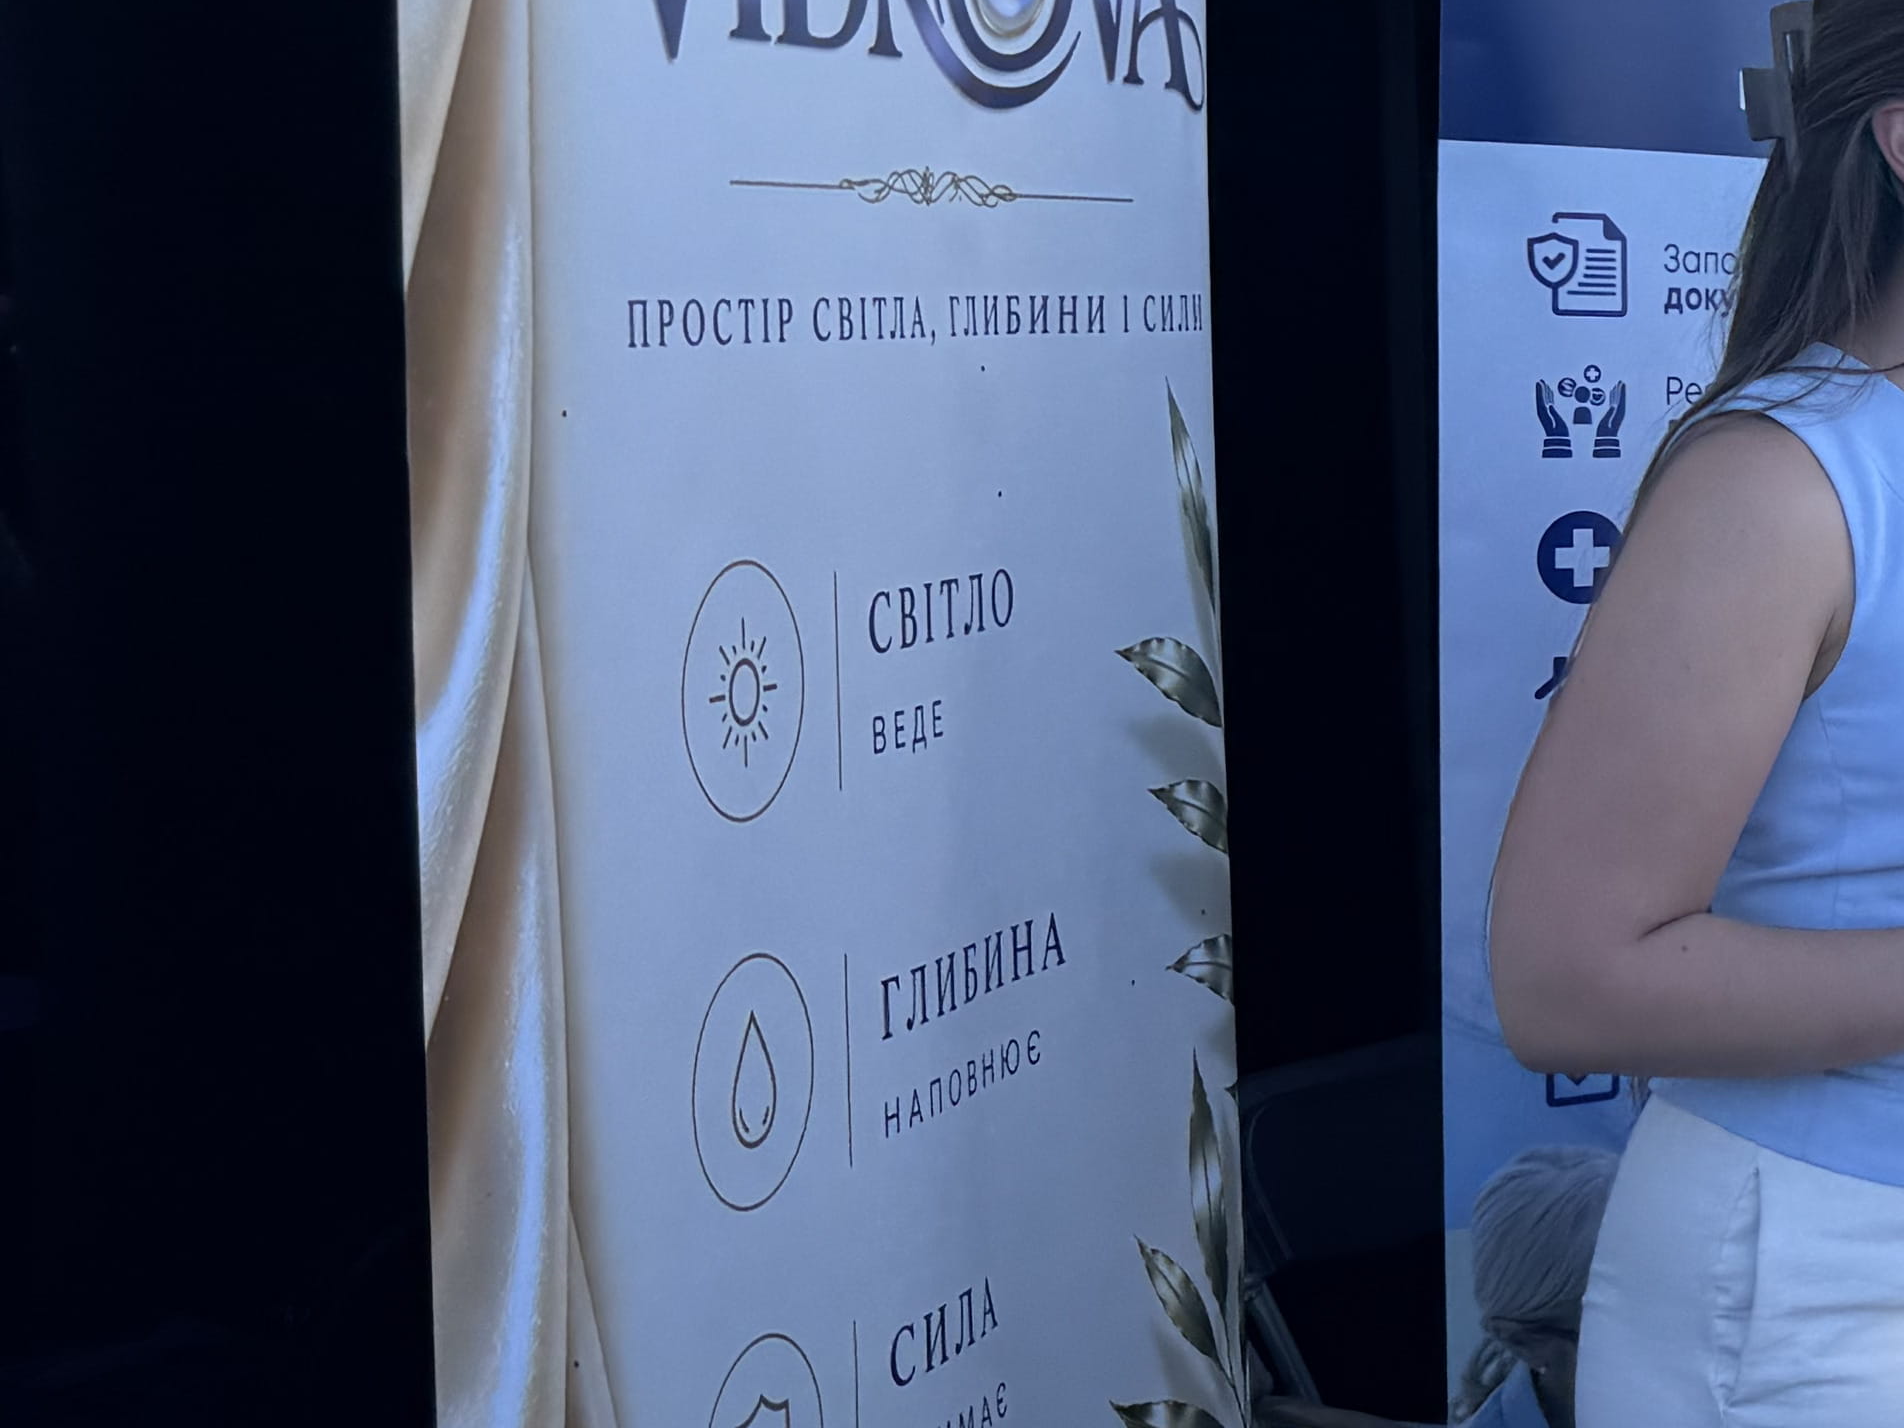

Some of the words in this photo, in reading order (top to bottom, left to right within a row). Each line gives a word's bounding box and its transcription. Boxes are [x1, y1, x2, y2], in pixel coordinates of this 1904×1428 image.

[627, 296, 794, 348] ПРОСТІР
[812, 294, 936, 346] СВІТЛА,
[947, 292, 1107, 339] ГЛИБИНИ
[866, 568, 1017, 657] СВІТЛО
[871, 700, 948, 757] ВЕДЕ
[879, 912, 1068, 1041] ГЛИБИНА
[881, 1027, 1044, 1140] НАПОВНЮЄ
[889, 1276, 1002, 1390] СИЛА
